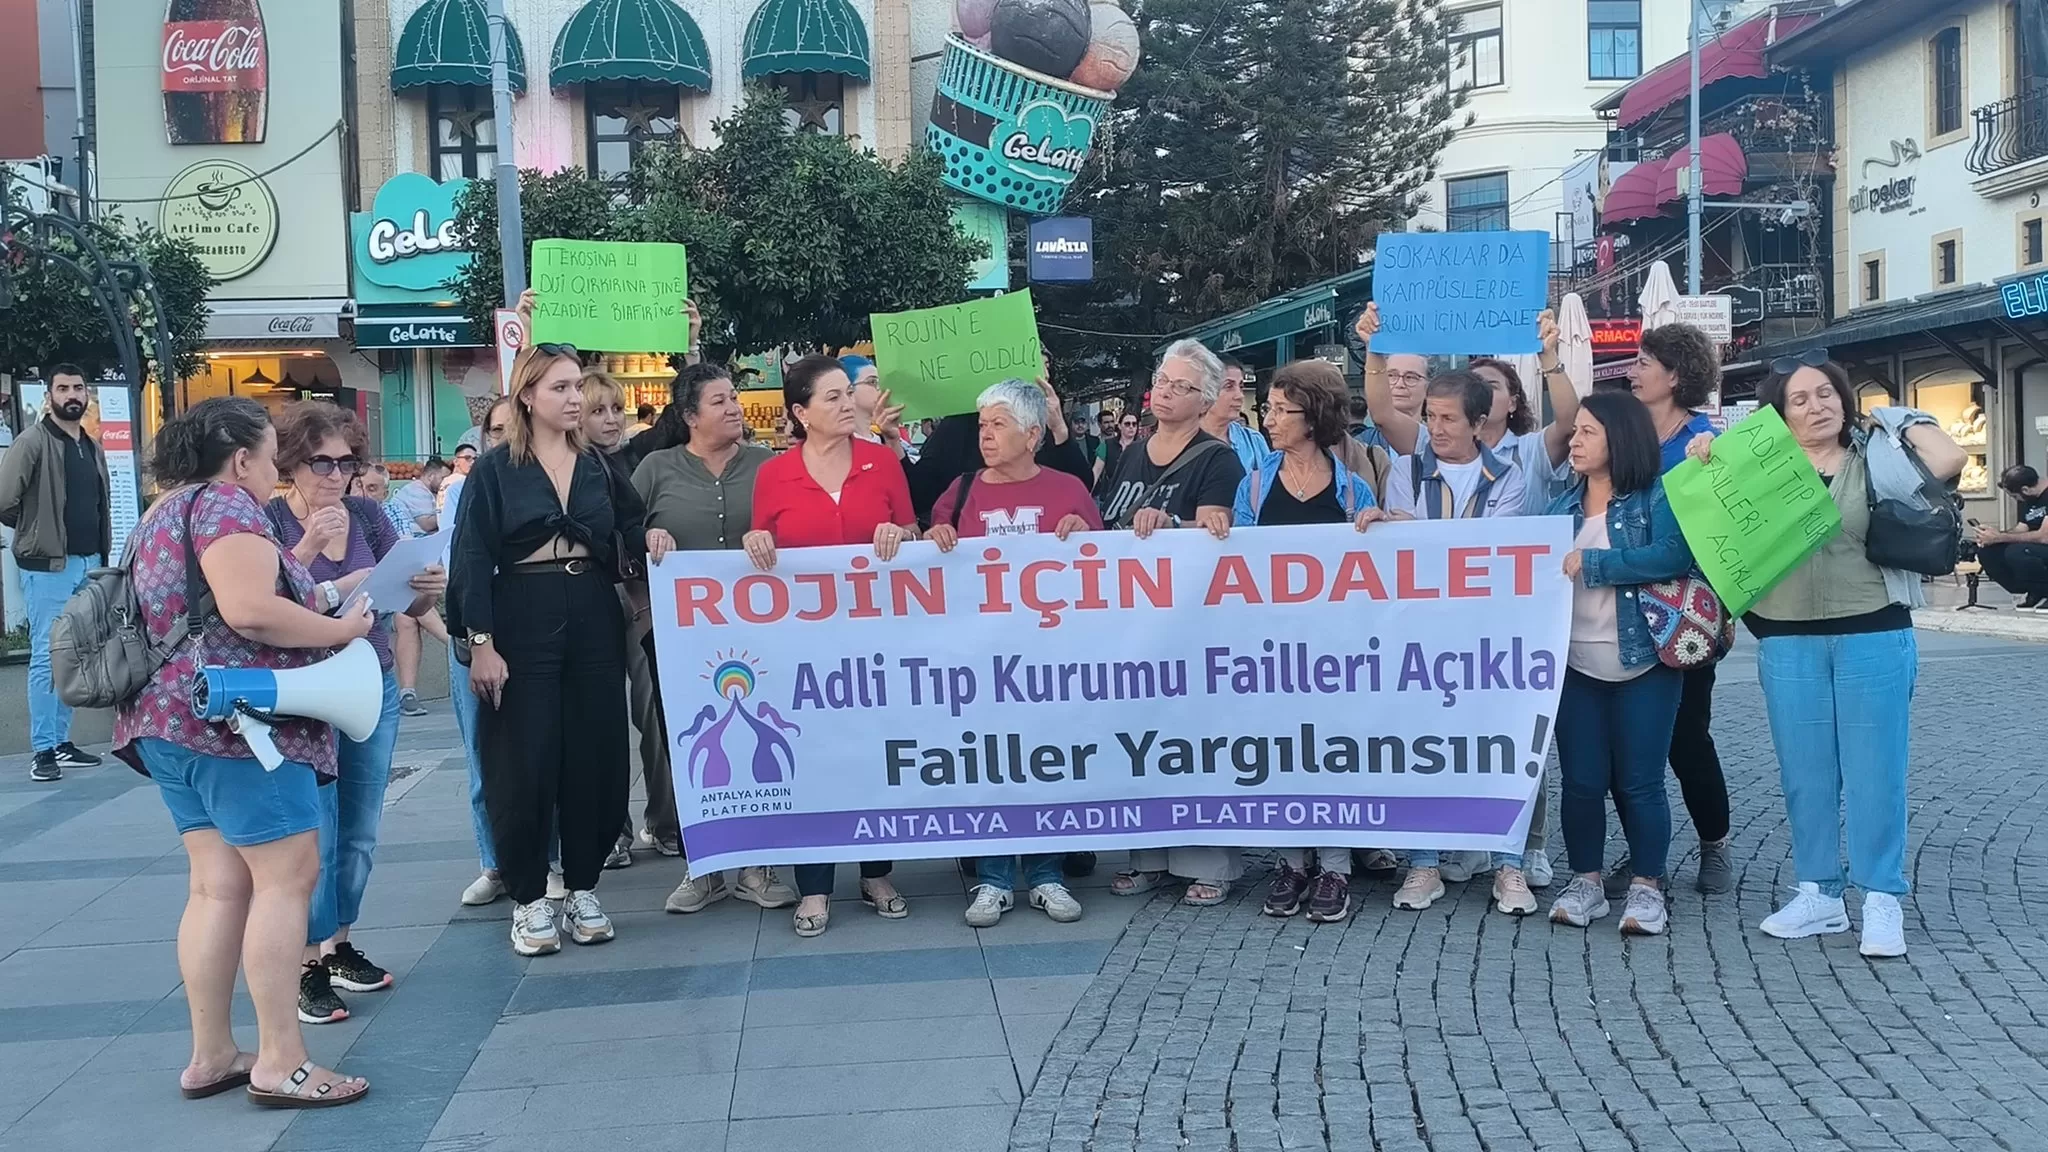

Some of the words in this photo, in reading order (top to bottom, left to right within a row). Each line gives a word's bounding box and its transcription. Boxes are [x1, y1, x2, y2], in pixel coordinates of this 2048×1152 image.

[163, 26, 261, 72] Coca-Cola
[223, 75, 237, 83] TAT
[170, 222, 221, 234] Artimo
[226, 222, 260, 234] Cafe
[1035, 237, 1089, 252] LAVAZZA
[1383, 243, 1490, 269] SOKAKLAR
[1499, 242, 1526, 266] DA
[1382, 275, 1524, 304] KAMPÜSLERDE
[389, 323, 457, 343] GeLatte
[919, 354, 952, 383] NE
[969, 336, 1038, 375] OLDU?
[674, 555, 947, 628] ROJİN
[976, 542, 1174, 629] İÇİN
[1203, 544, 1552, 606] ADALET
[791, 652, 888, 711] Adli
[899, 657, 977, 717] Tıp
[993, 653, 1187, 706] Kurumu
[1205, 637, 1381, 694] Failleri
[1397, 637, 1556, 707] Açıkla
[884, 731, 1098, 787] Failler
[1115, 714, 1551, 787] Yargılansın!
[701, 790, 752, 804] ANTALYA
[755, 788, 791, 798] KADIN
[702, 802, 793, 818] PLATFORMU
[853, 811, 1008, 839] ANTALYA
[1036, 804, 1141, 831] KADIN
[1171, 802, 1386, 826] PLATFORMU
